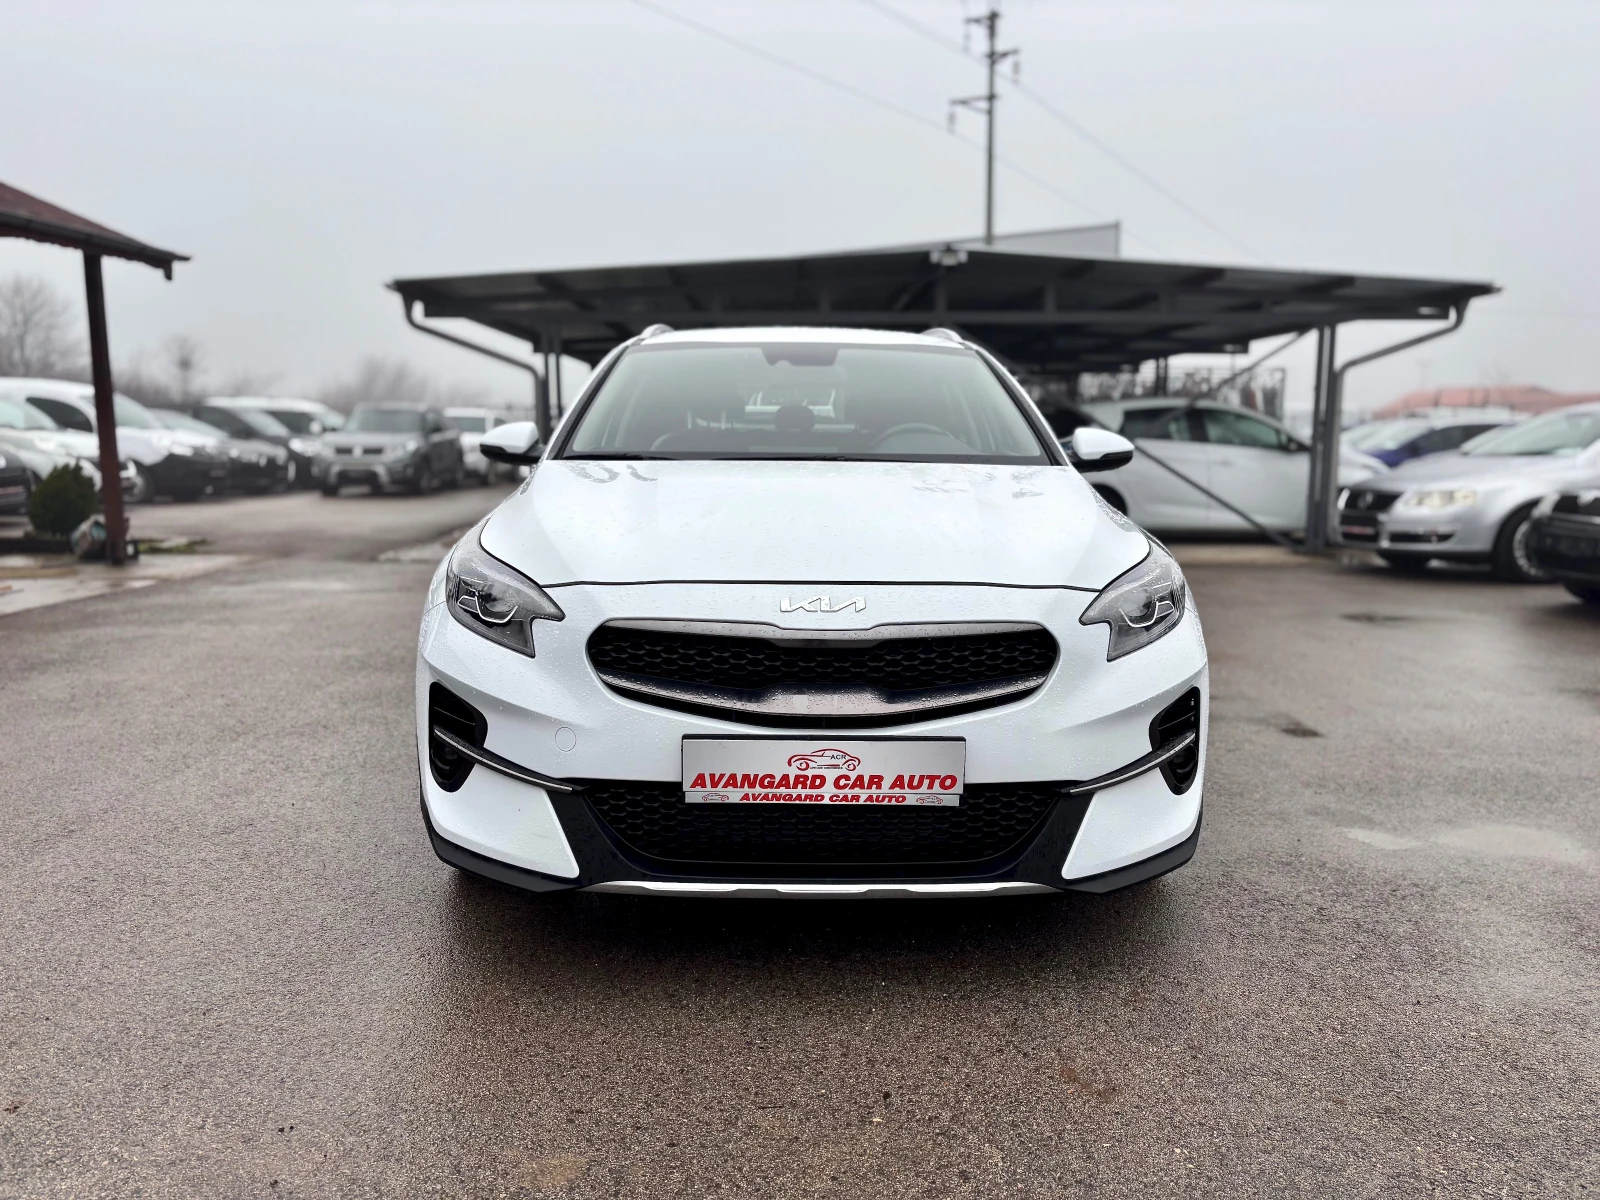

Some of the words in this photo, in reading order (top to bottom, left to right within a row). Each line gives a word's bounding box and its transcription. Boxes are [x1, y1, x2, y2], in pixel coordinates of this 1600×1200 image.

[780, 596, 866, 613] KIA
[690, 773, 826, 790] AVANGARD
[833, 774, 884, 791] CAR
[889, 774, 958, 791] AUTO
[739, 792, 825, 803] AVANGARD
[829, 794, 861, 804] CAR
[863, 794, 907, 804] AUTO
